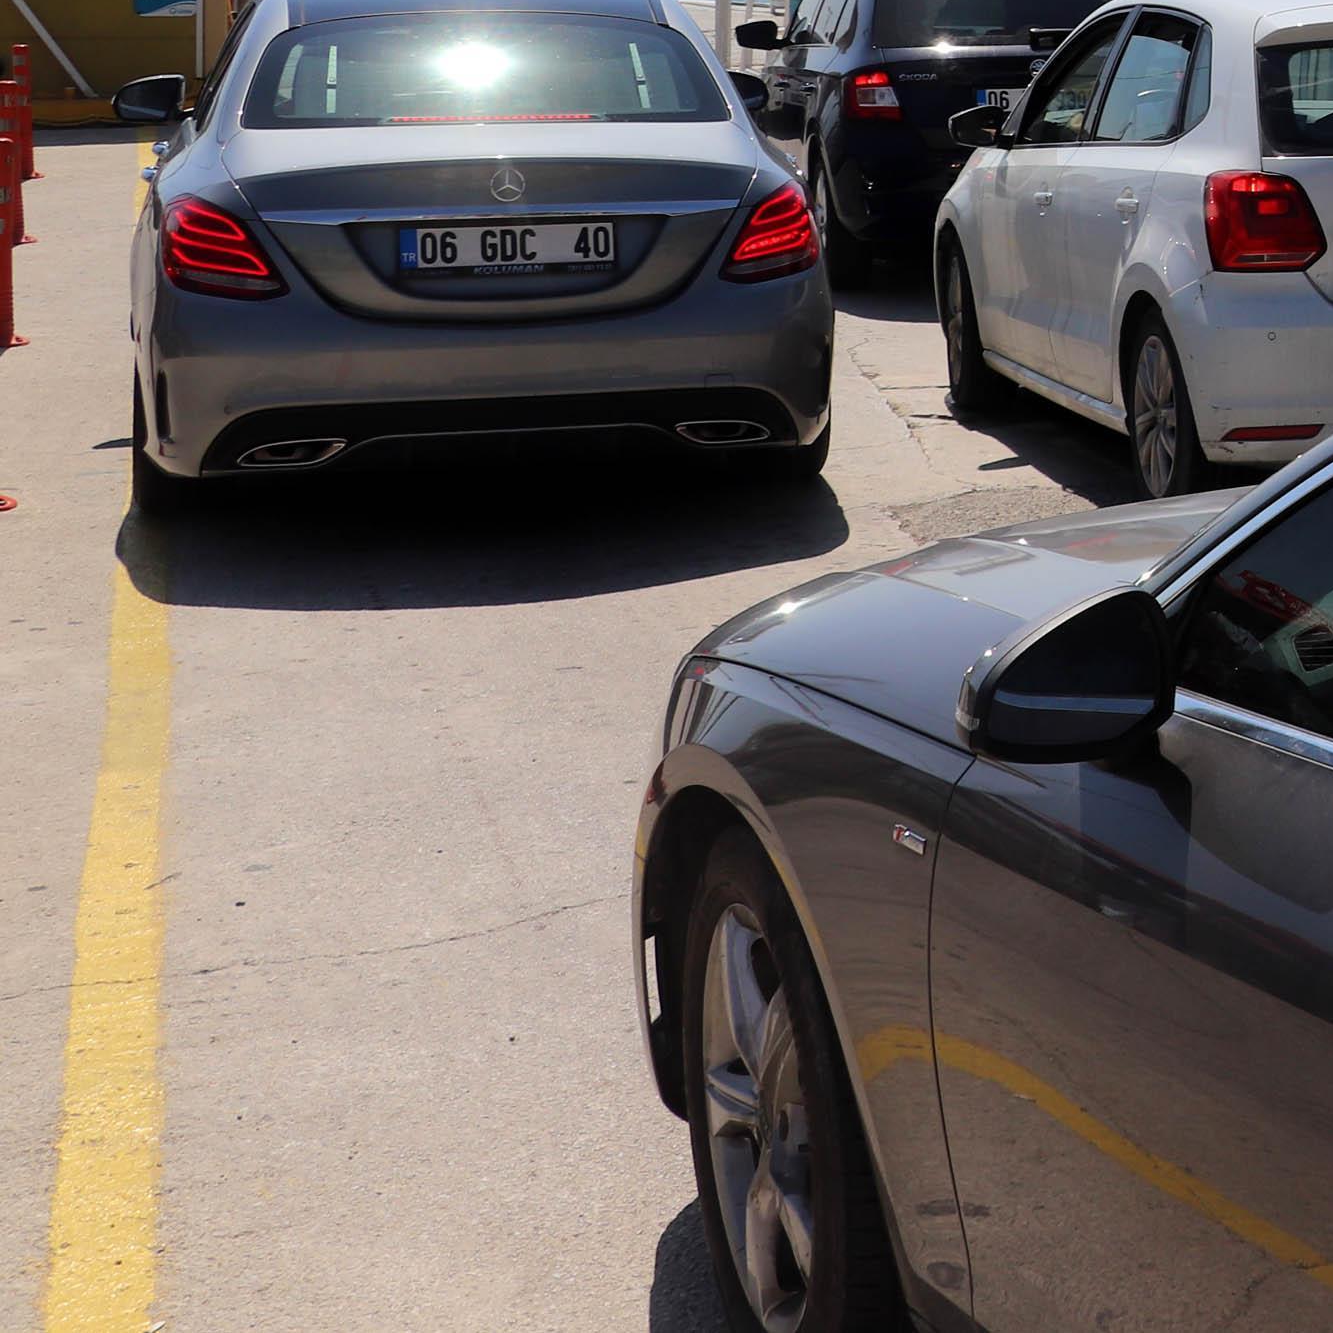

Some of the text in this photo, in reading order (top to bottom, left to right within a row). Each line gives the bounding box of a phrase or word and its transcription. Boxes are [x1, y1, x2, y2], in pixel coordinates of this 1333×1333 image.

[988, 90, 1010, 111] 06
[420, 225, 611, 265] 06 GDC 40
